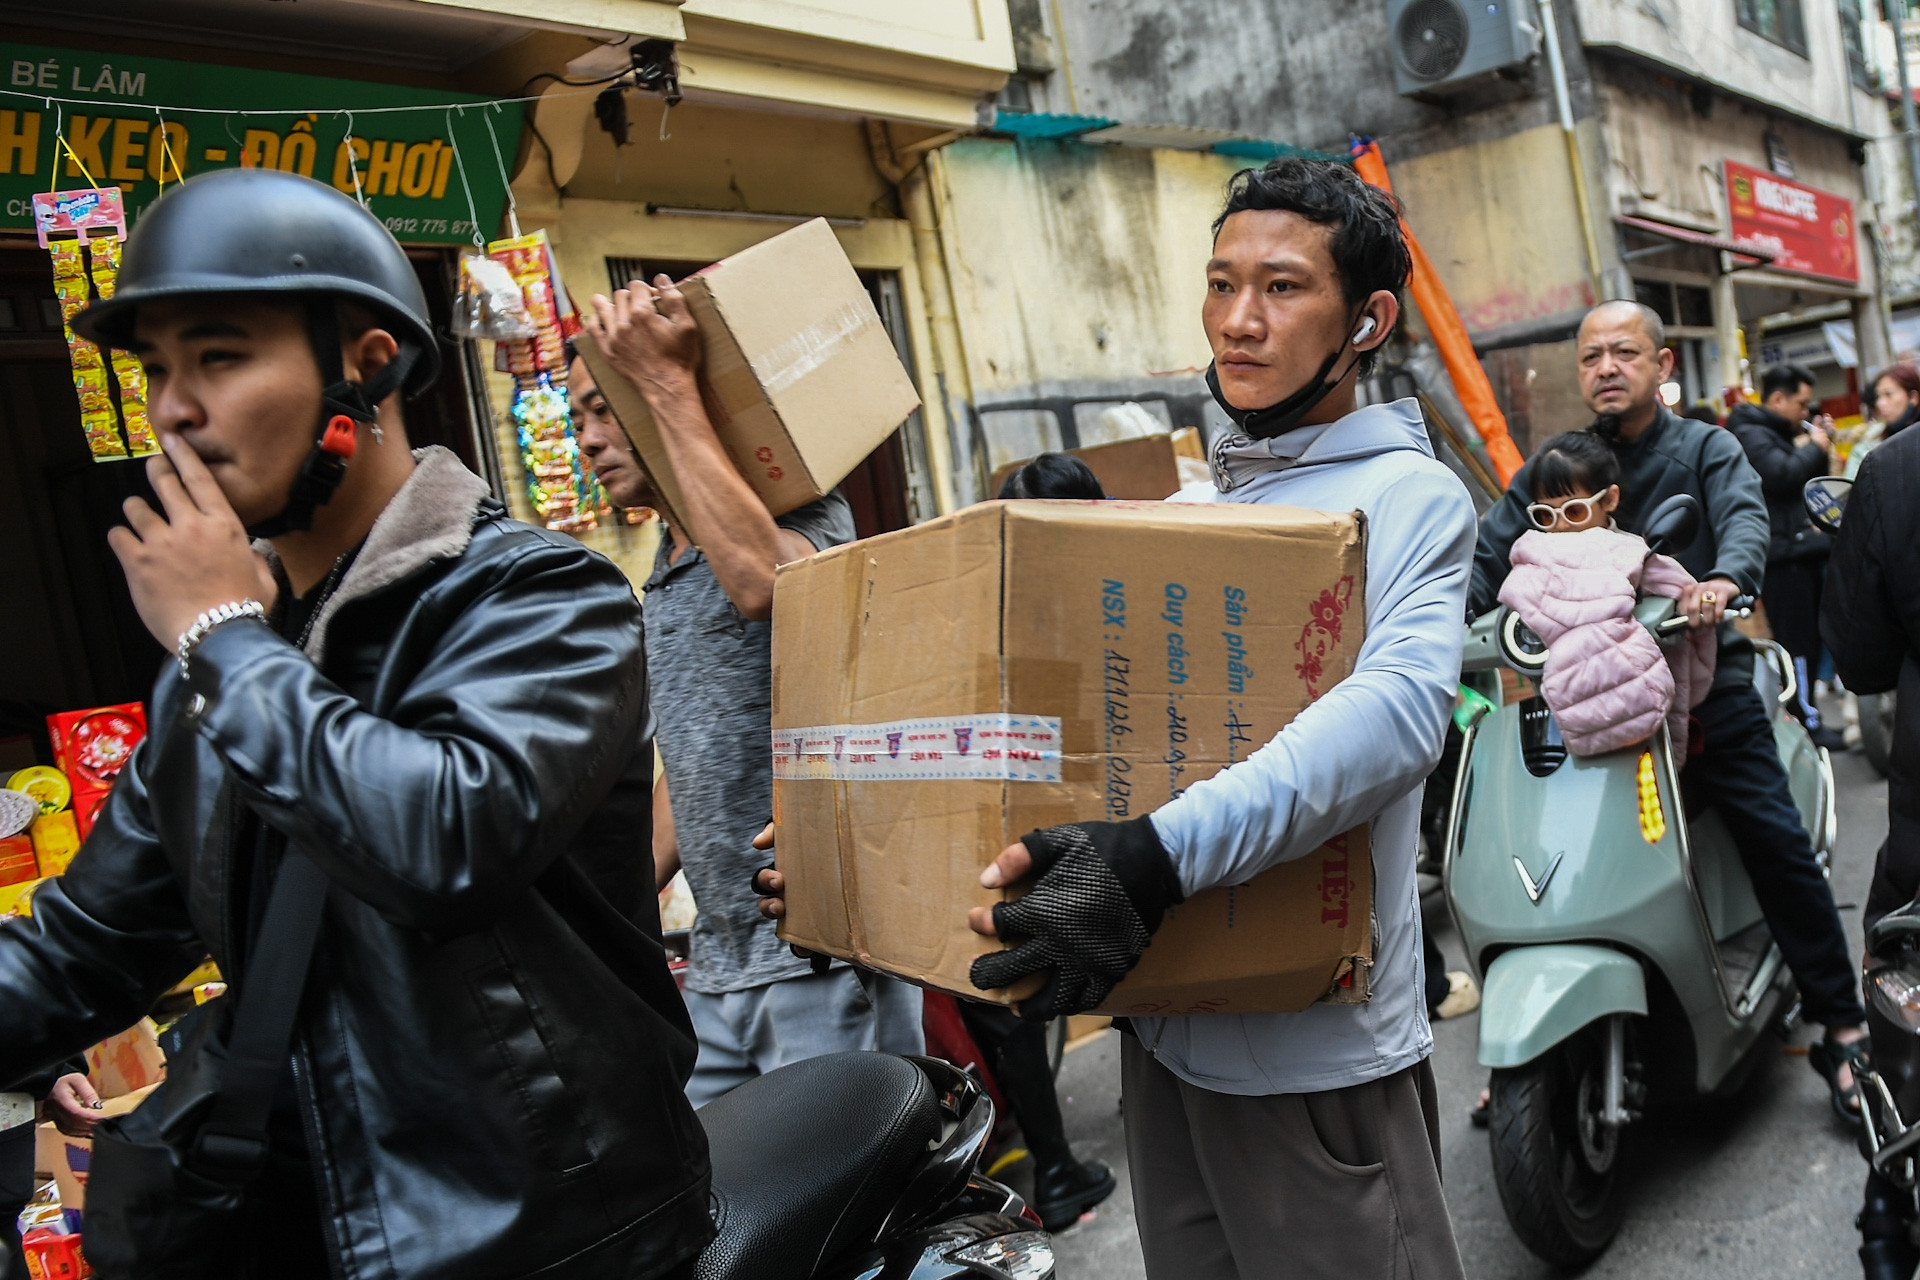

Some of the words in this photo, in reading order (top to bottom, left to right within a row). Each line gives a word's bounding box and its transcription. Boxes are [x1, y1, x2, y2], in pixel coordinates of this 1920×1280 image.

[11, 58, 60, 89] BÉ
[71, 63, 146, 97] LÂM
[332, 136, 455, 198] CHƠI
[385, 216, 418, 233] 0912
[421, 218, 448, 234] 775
[1102, 579, 1126, 629] NSX
[1161, 582, 1188, 628] Quy
[1224, 585, 1248, 626] Sản
[1166, 632, 1190, 686] cách
[1221, 631, 1255, 694] phẩm
